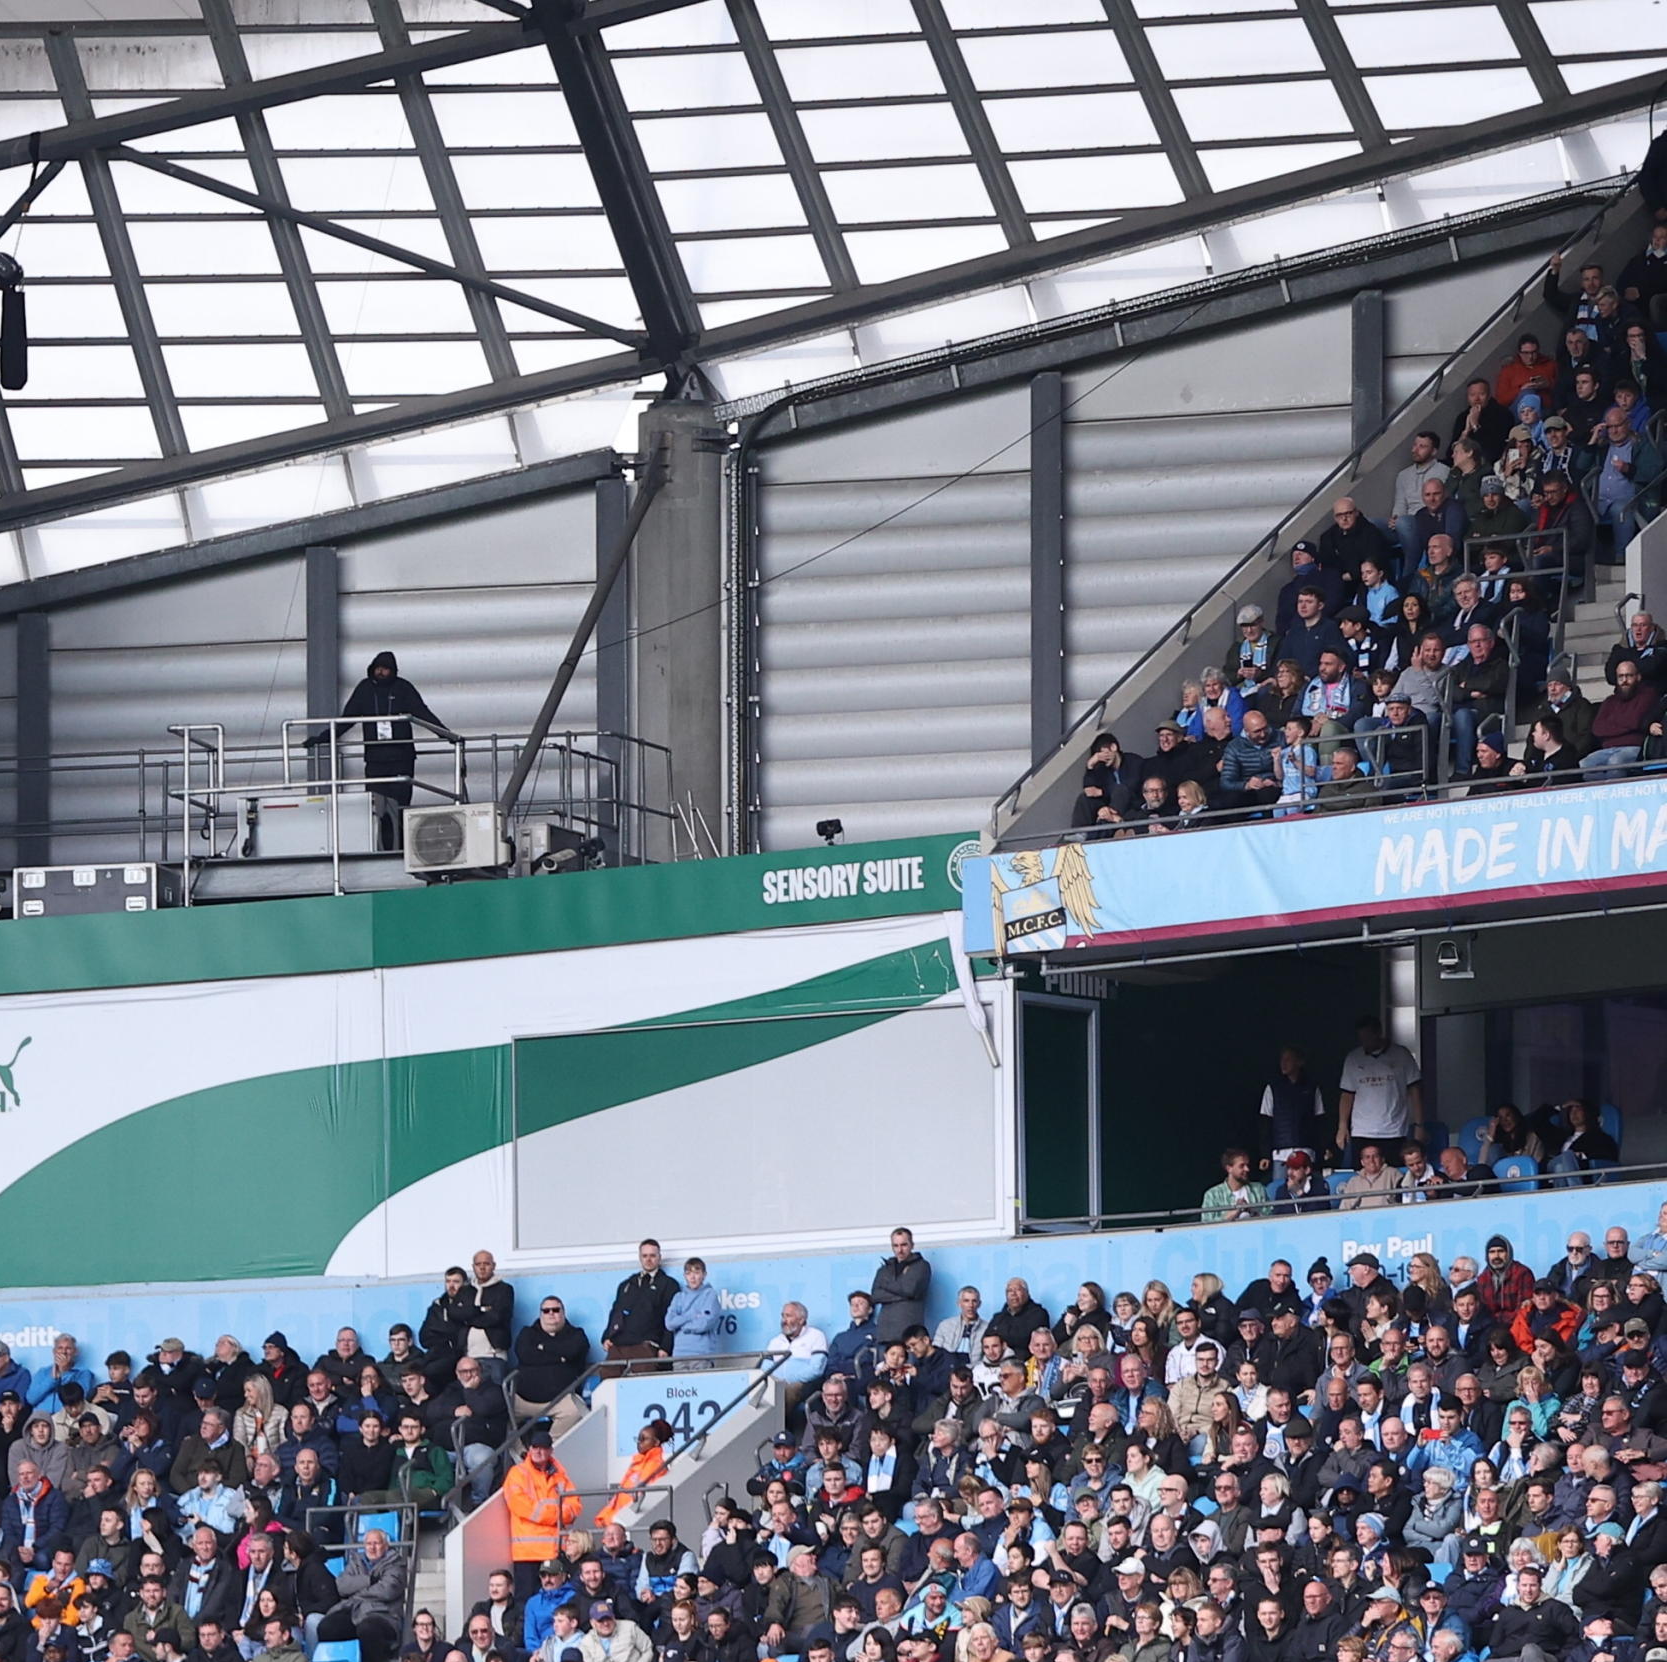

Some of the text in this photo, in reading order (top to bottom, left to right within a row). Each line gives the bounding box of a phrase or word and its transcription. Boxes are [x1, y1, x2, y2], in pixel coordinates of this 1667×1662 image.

[1427, 809, 1448, 820] NOT
[1488, 802, 1510, 812] NOT
[1513, 798, 1555, 810] REALLY
[1374, 821, 1518, 896] MADE
[1537, 815, 1594, 878] IN
[763, 857, 924, 905] SENSORY SUITE
[1007, 910, 1063, 940] M.C.F.C.
[1388, 1233, 1433, 1258] Paul
[719, 1288, 760, 1310] kes
[667, 1387, 698, 1398] Block
